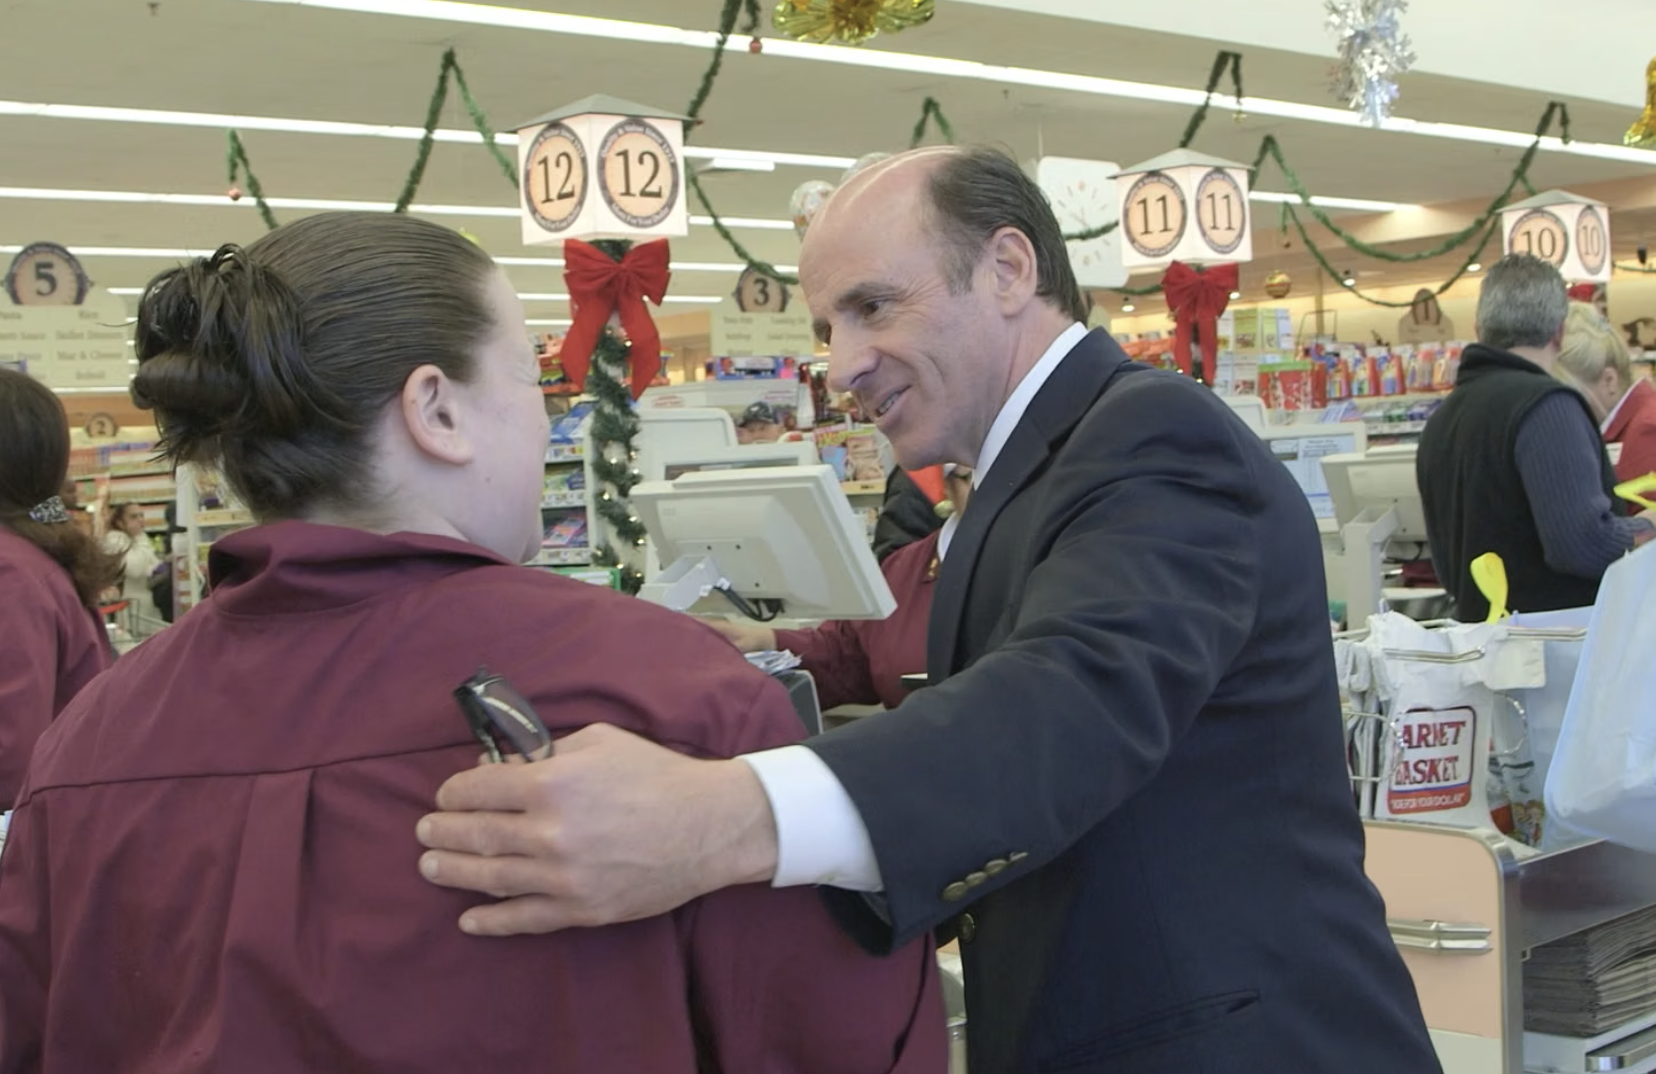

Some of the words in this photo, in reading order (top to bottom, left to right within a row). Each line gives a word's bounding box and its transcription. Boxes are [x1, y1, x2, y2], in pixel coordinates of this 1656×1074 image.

[537, 151, 576, 204] 12
[615, 148, 662, 199] 12
[1136, 194, 1173, 236] 11
[1206, 192, 1235, 231] 11
[1521, 227, 1556, 258] 10
[1581, 225, 1600, 256] 10
[34, 261, 57, 296] 5
[753, 278, 770, 306] 3
[96, 420, 107, 434] 2
